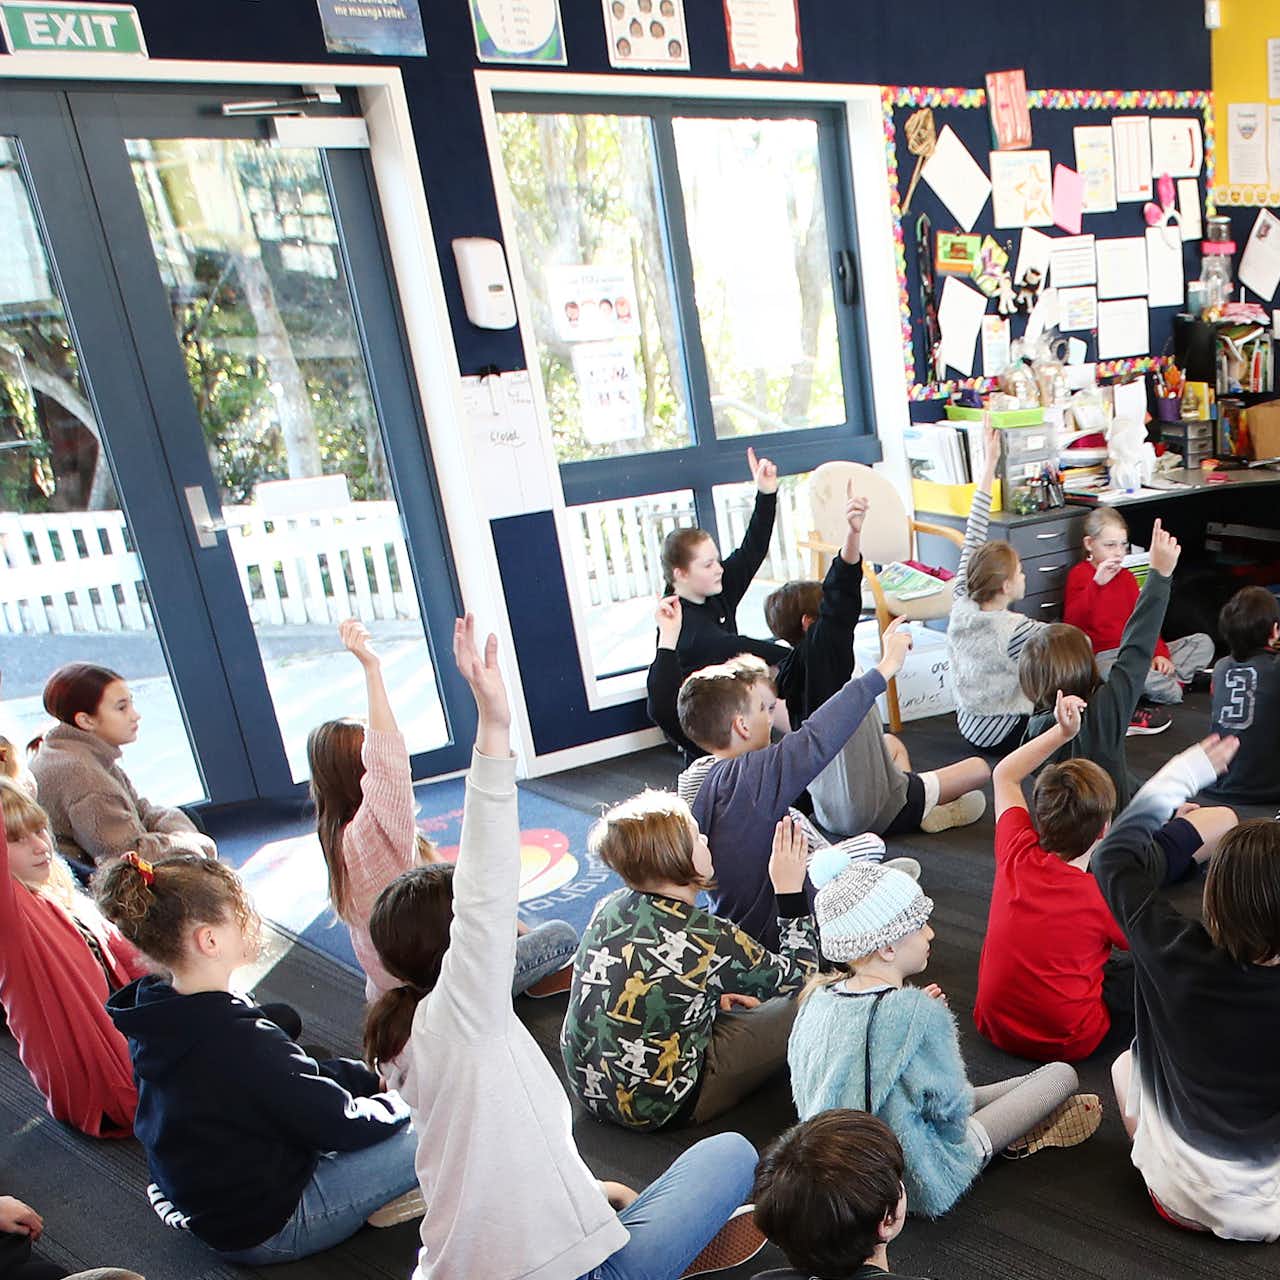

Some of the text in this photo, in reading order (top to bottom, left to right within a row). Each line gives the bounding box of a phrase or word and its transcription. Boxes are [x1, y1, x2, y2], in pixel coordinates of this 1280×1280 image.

[22, 11, 118, 48] EXIT
[930, 660, 950, 674] one
[1217, 665, 1258, 731] 3
